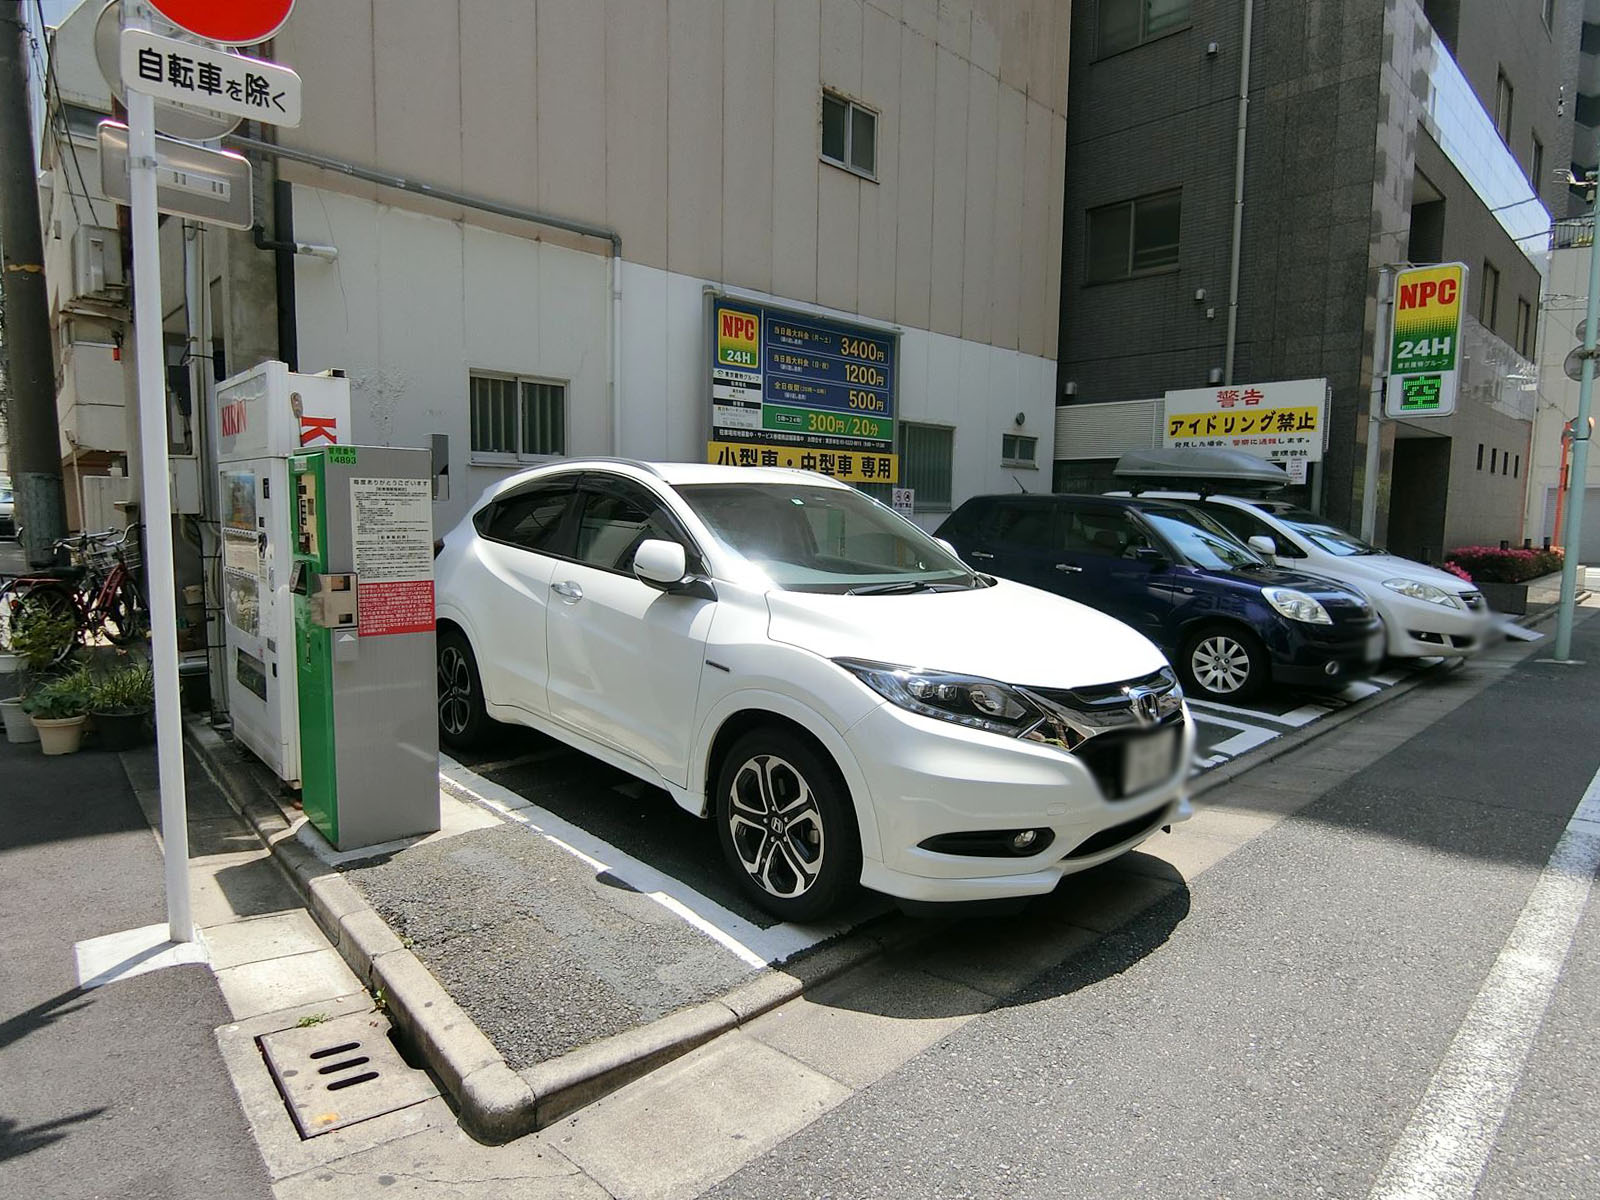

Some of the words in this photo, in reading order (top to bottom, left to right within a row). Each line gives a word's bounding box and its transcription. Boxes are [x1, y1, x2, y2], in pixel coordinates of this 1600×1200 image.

[138, 47, 287, 113] 自転車を除く
[1399, 278, 1457, 310] NPC
[722, 314, 755, 341] NPC
[727, 350, 751, 364] 24H
[840, 337, 884, 361] 3400円
[1397, 336, 1451, 359] 24H
[845, 363, 884, 386] 1200円
[849, 390, 884, 411] 500円
[1216, 388, 1265, 408] 警告
[1400, 375, 1441, 411] 空
[808, 413, 879, 437] 300円/20分
[1170, 410, 1315, 436] アイドリング禁止
[329, 456, 357, 465] 14893
[718, 446, 853, 477] 小型車・中型車
[861, 456, 891, 479] 専用
